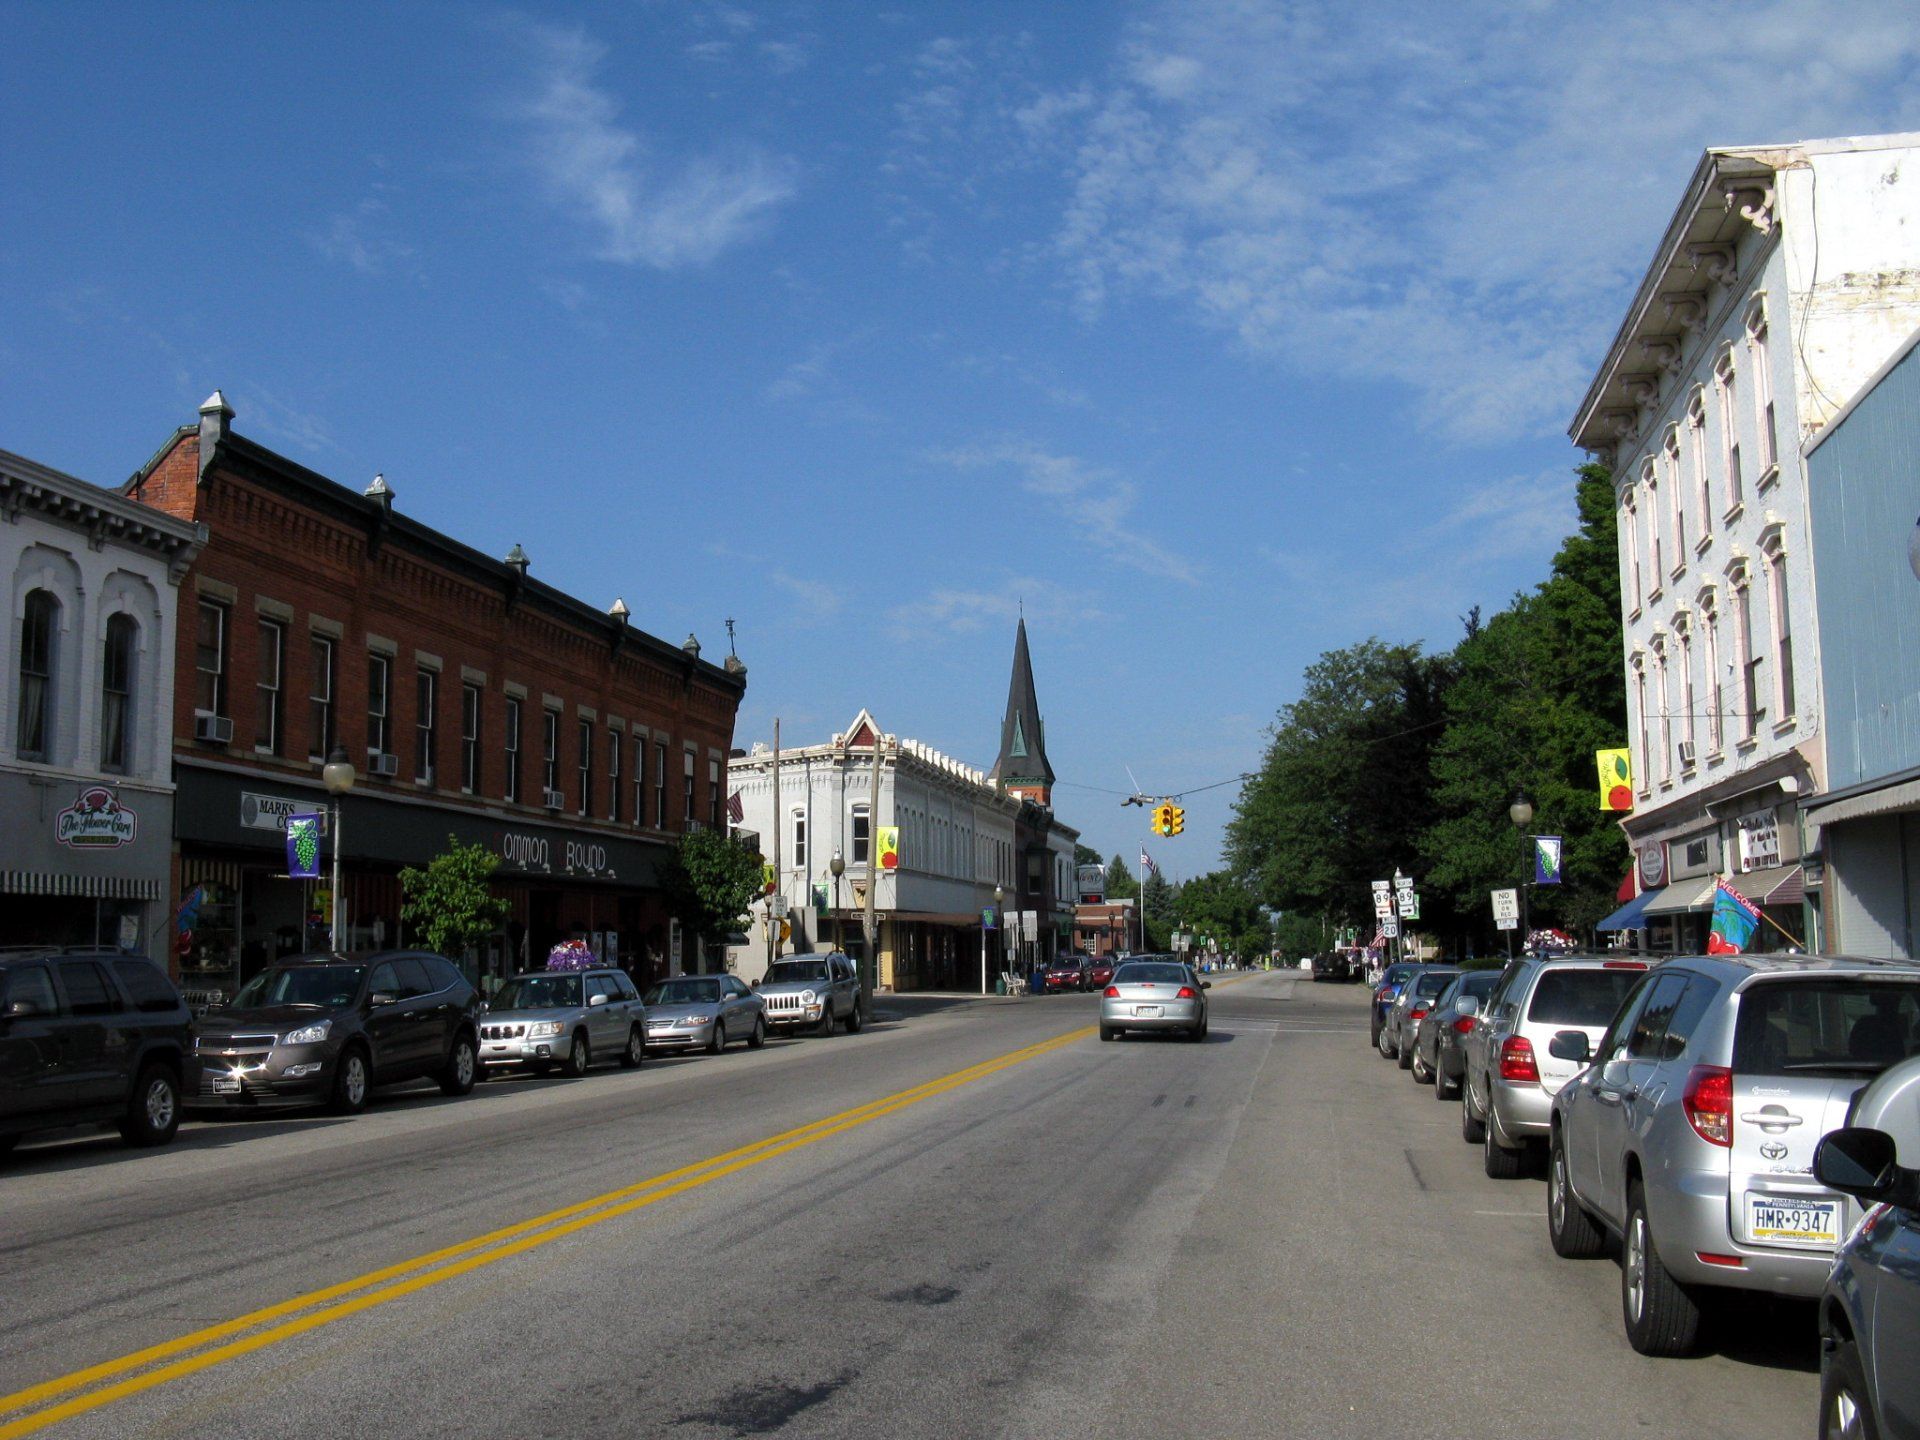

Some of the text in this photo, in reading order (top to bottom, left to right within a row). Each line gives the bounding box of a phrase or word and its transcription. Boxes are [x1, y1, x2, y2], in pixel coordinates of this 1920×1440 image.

[259, 800, 295, 816] MARKS
[60, 814, 79, 836] The
[1375, 894, 1389, 903] 89
[1399, 891, 1413, 902] 89
[1498, 891, 1510, 900] NO
[1718, 880, 1761, 917] WELCOME
[1384, 925, 1396, 935] 20
